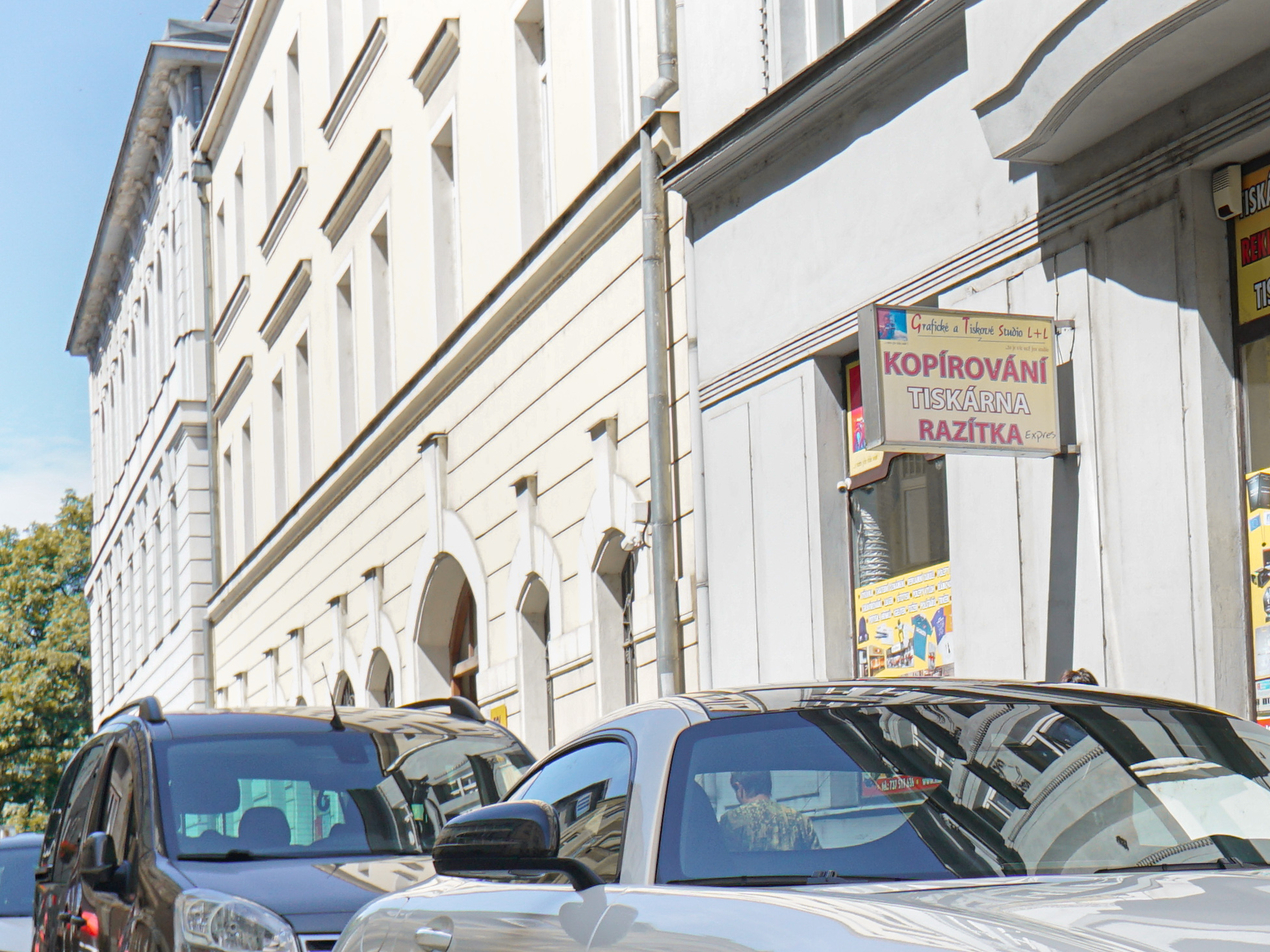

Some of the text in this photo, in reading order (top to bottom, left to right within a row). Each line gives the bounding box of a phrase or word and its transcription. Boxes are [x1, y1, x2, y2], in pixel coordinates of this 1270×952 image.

[911, 313, 1048, 340] Grafické a Tiskové Studio L+L
[884, 350, 1048, 384] KOPÍROVÁNÍ
[907, 385, 1031, 415] TISKÁRNA
[919, 417, 1056, 445] RAZÍTKA Expres
